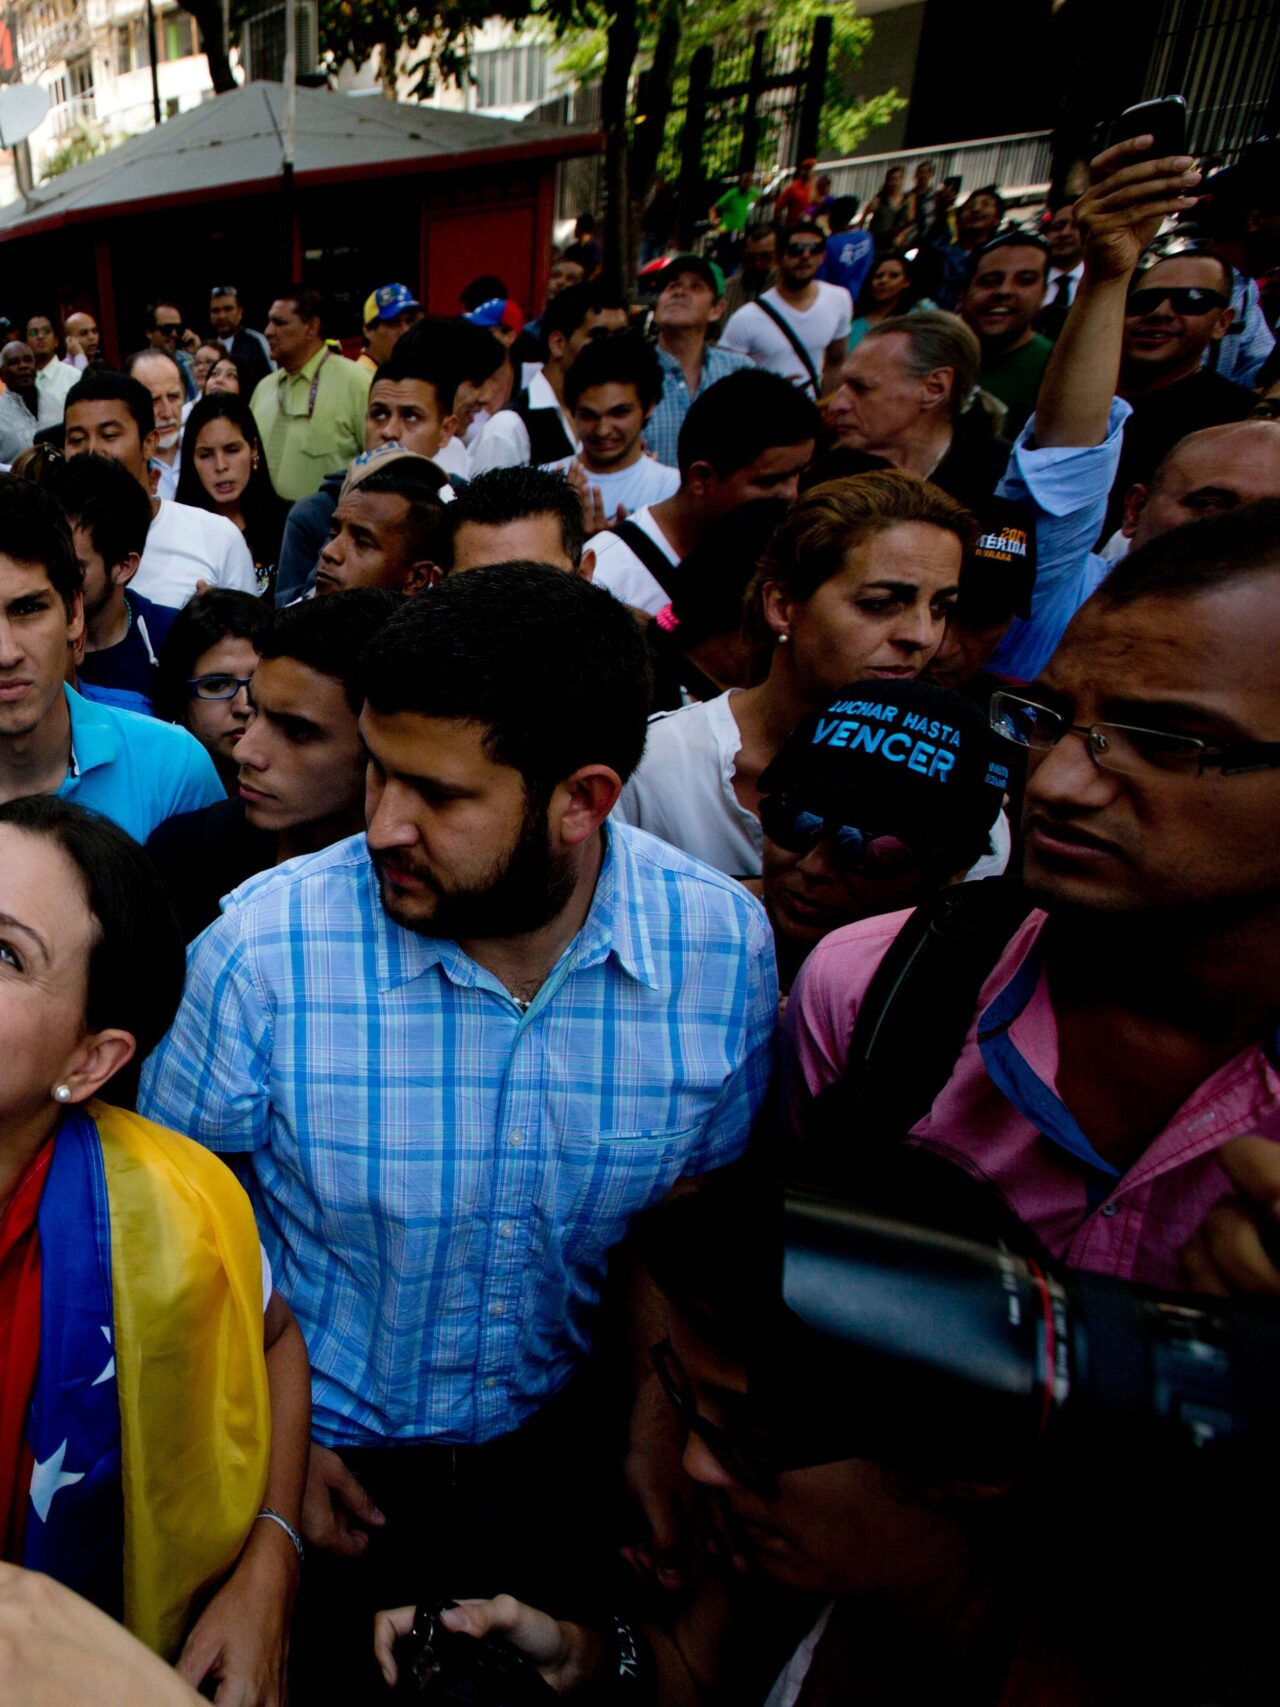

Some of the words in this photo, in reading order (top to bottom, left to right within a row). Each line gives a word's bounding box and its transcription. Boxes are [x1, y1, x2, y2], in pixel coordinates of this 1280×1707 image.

[810, 717, 957, 783] VENCER
[827, 698, 900, 723] LUCHAR
[902, 711, 961, 748] HASTA
